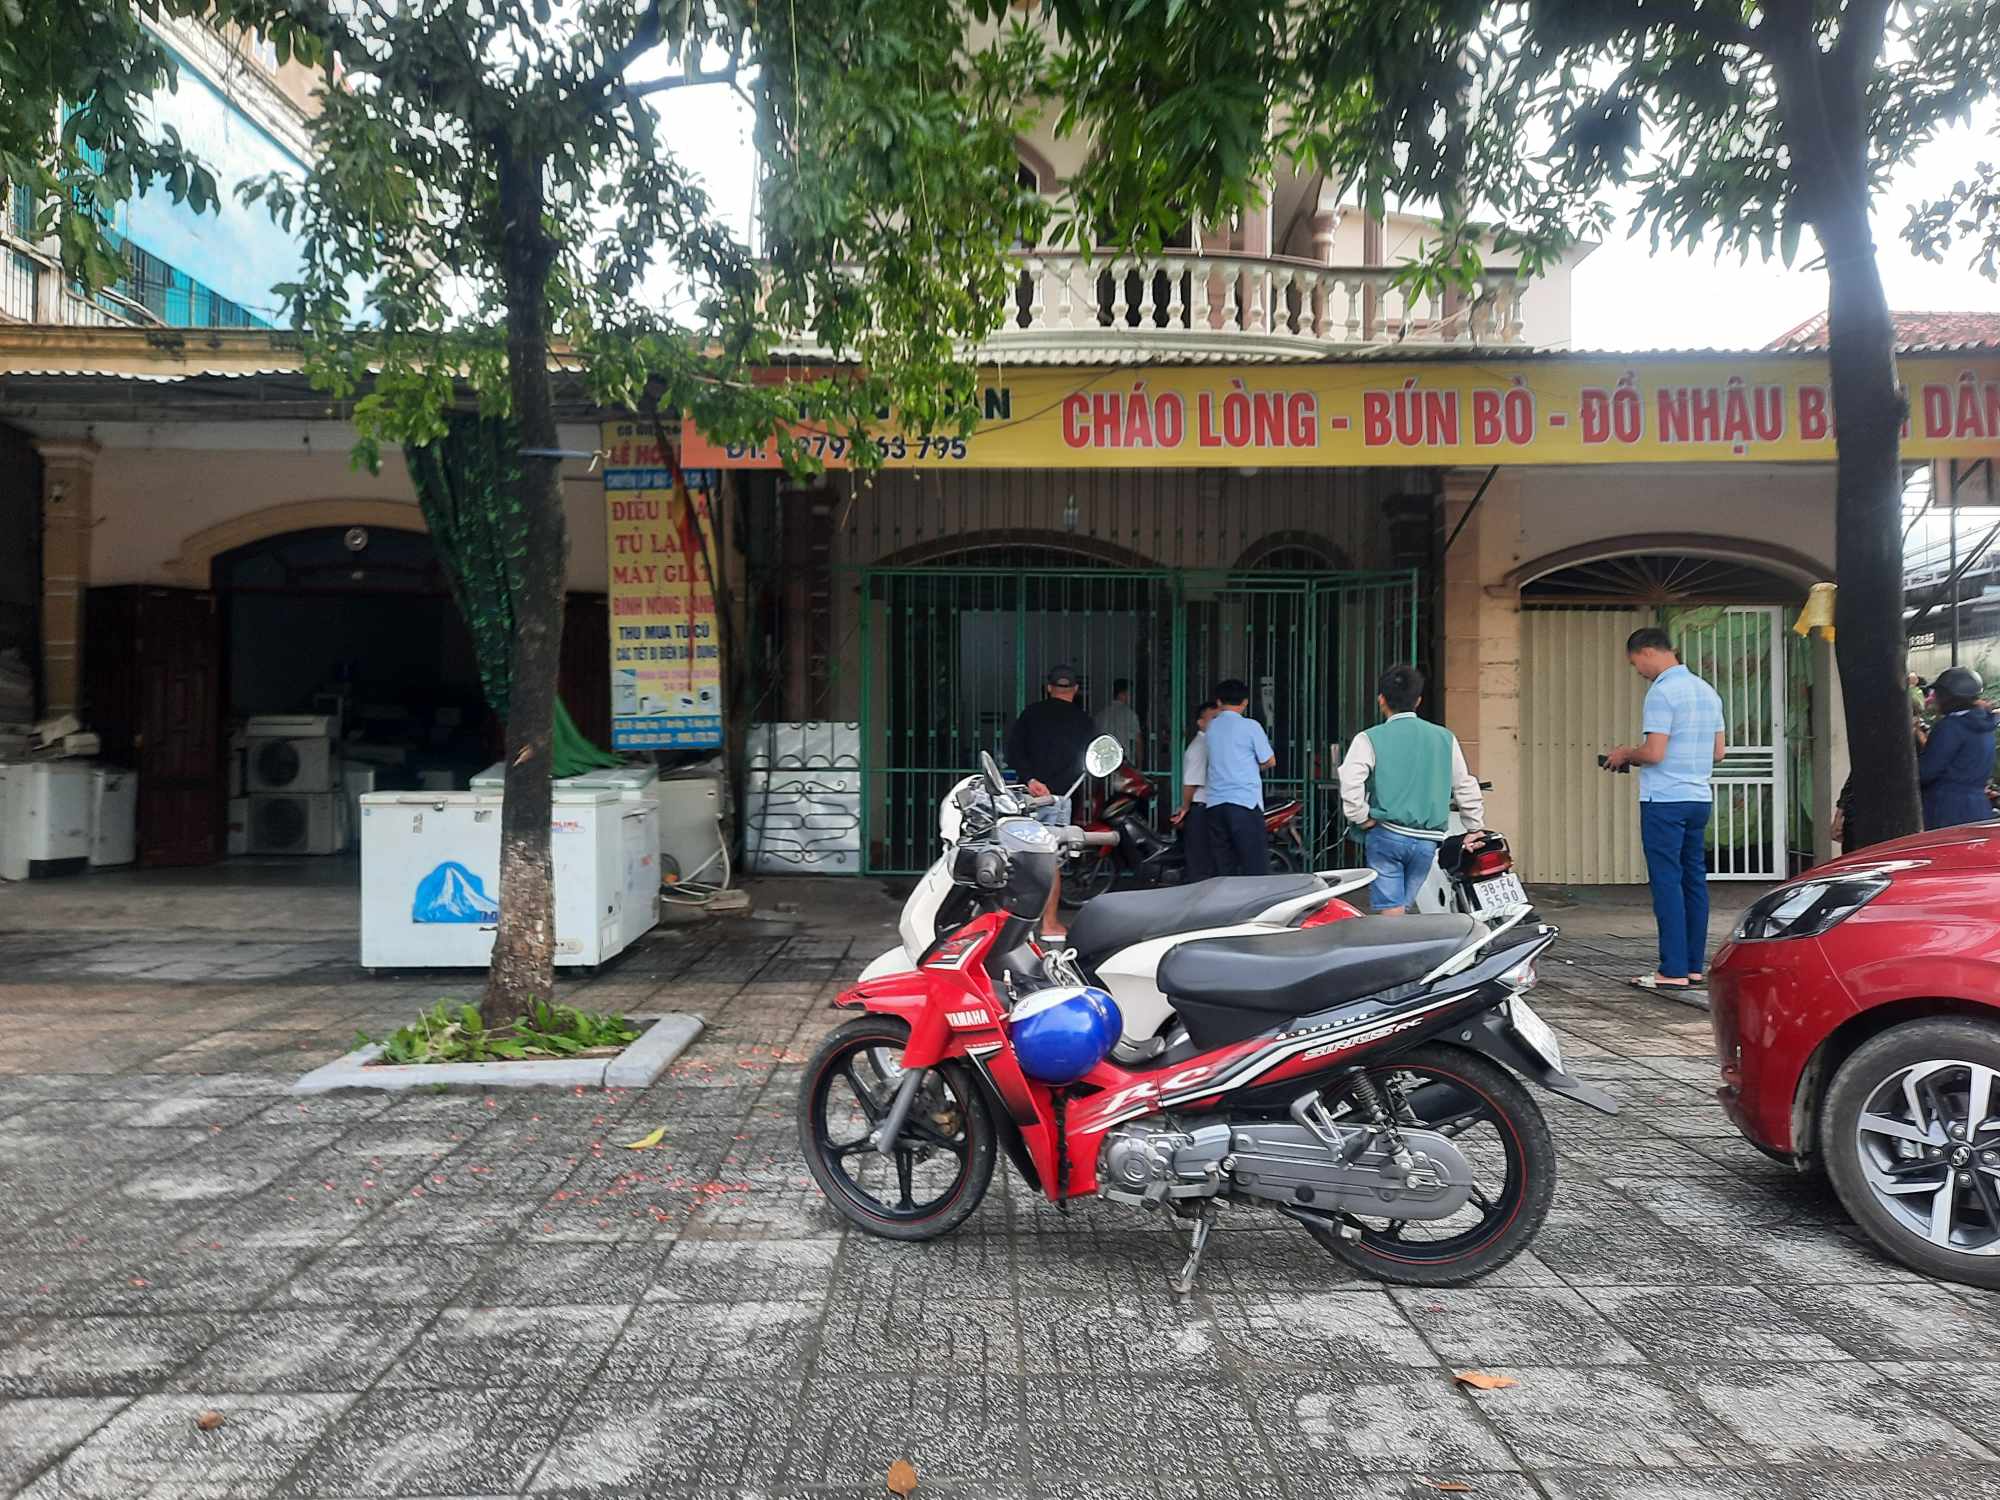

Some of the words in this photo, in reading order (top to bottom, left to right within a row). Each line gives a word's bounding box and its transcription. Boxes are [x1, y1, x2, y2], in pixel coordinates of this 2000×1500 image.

[1062, 381, 1184, 448] CHÁO
[1198, 379, 1319, 448] LÒNG
[1363, 378, 1459, 446] BÚN
[1473, 375, 1534, 445] BÒ
[1657, 376, 1785, 454] NHẬU
[915, 436, 967, 459] 795
[615, 526, 643, 553] TỦ
[613, 560, 656, 584] MÁY
[944, 1008, 991, 1028] YAMAHA
